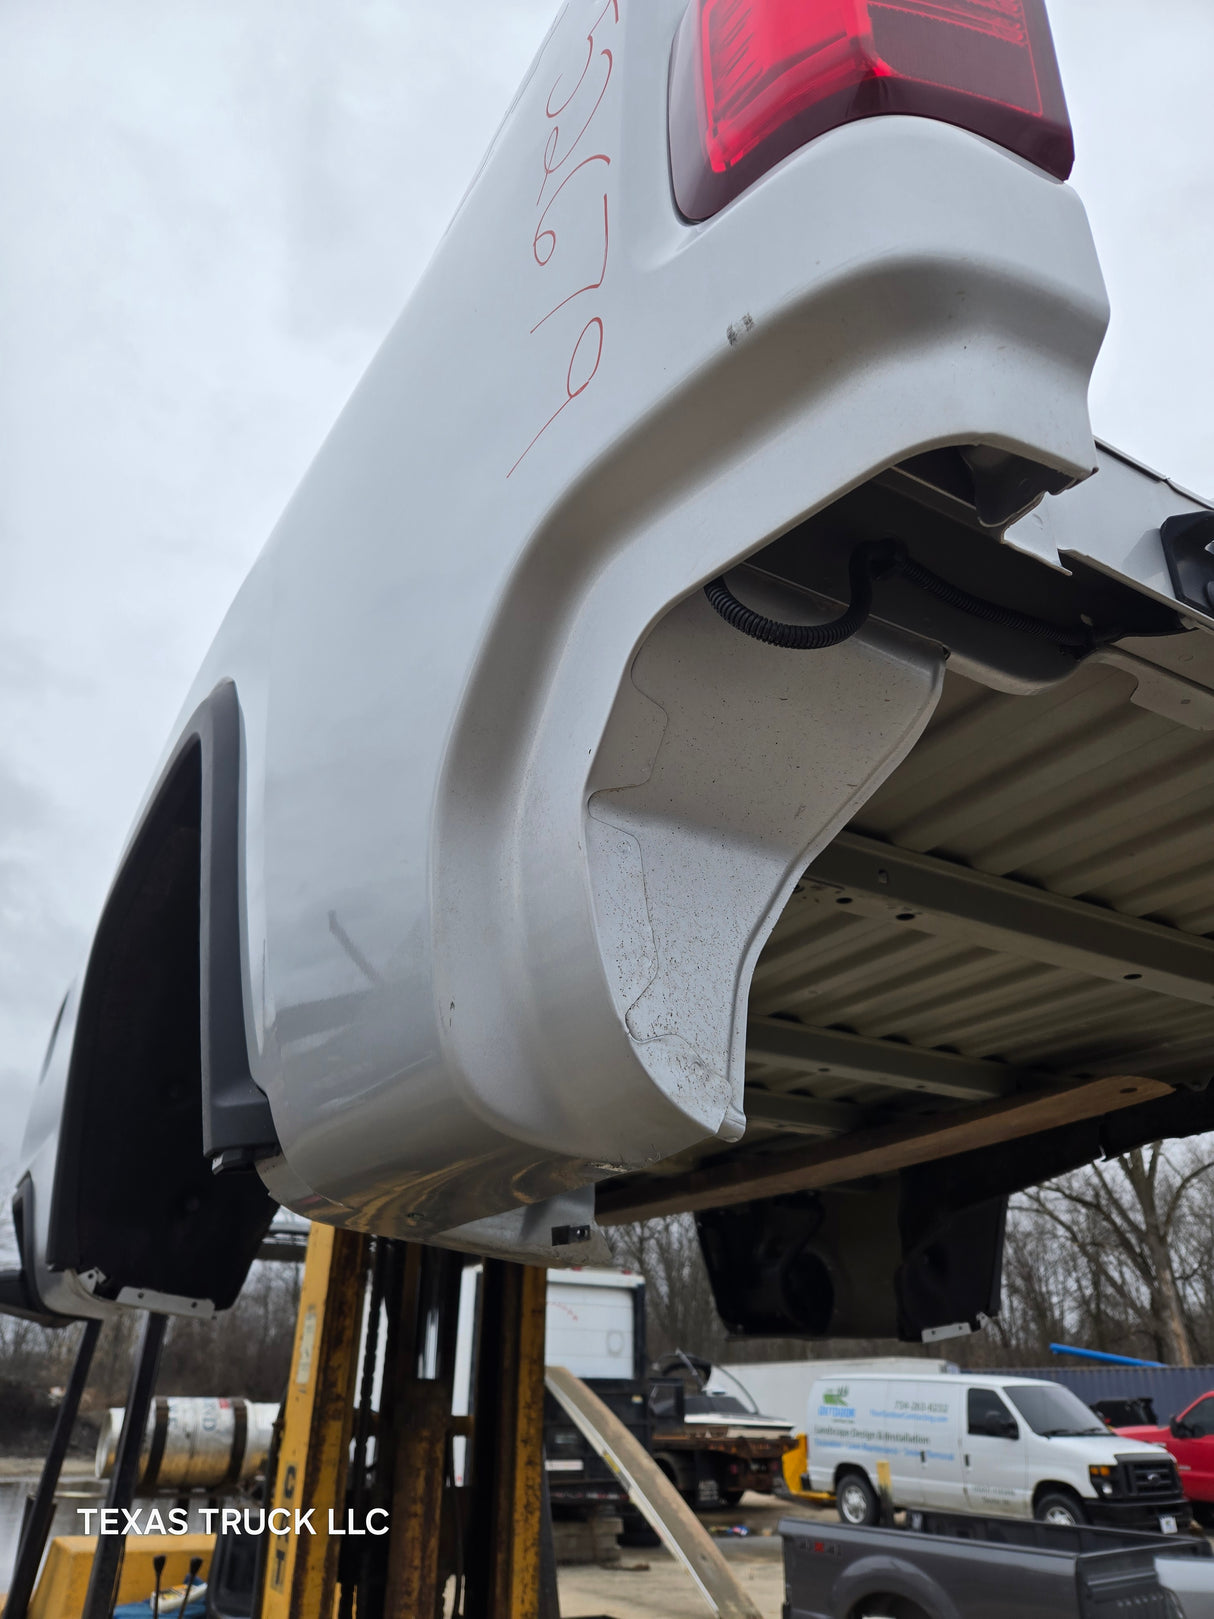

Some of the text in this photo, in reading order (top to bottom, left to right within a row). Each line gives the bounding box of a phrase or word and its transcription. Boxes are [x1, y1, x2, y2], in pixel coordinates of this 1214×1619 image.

[814, 1425, 849, 1438] Landscape
[850, 1428, 876, 1441] Design
[884, 1431, 930, 1444] Installation
